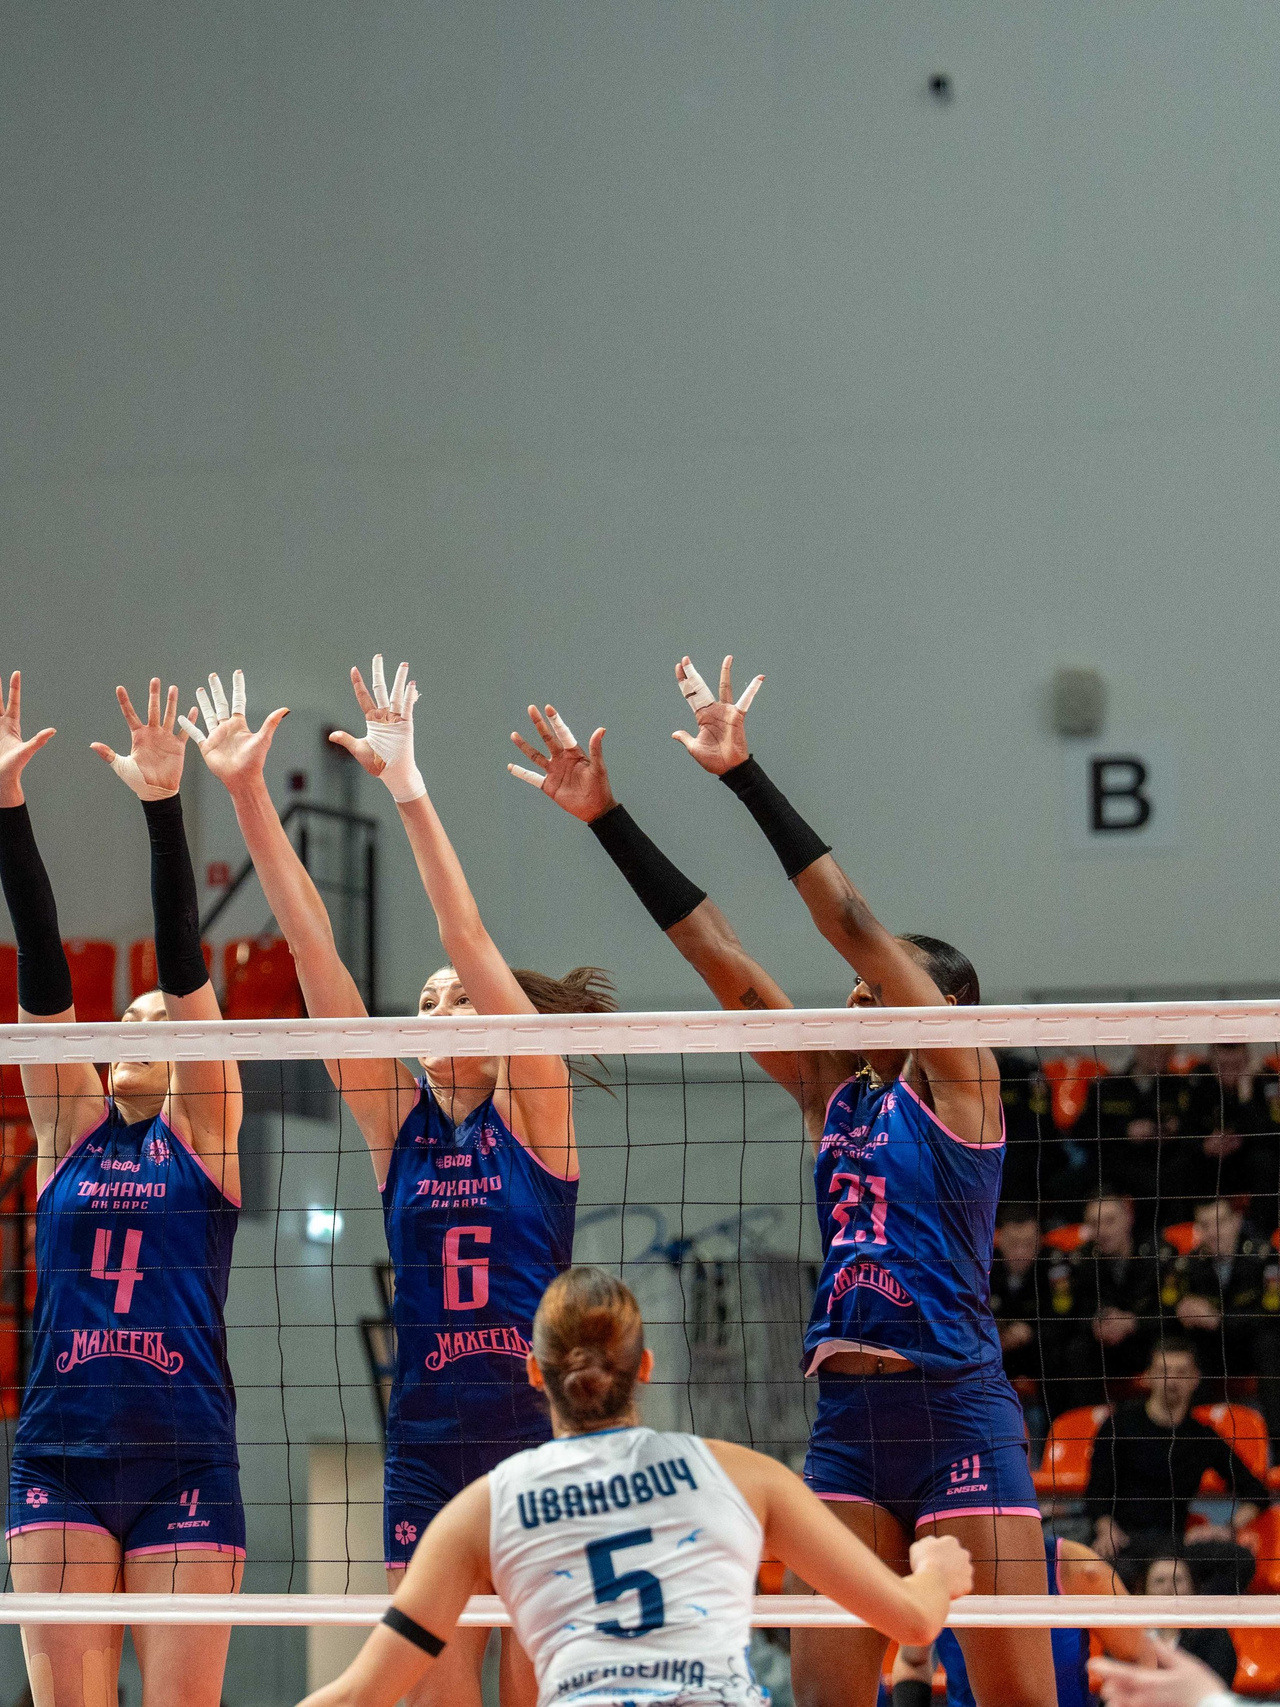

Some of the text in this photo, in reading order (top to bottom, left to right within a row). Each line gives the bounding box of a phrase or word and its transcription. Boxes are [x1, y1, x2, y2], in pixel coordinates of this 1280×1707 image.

[77, 1181, 166, 1198] ДИНАМО
[416, 1175, 502, 1197] ДИНАМО
[113, 1200, 149, 1210] БАРС
[829, 1172, 888, 1247] 21
[90, 1228, 144, 1314] 4
[442, 1225, 492, 1311] 6
[179, 1488, 200, 1517] 4
[946, 1484, 988, 1496] ENSEN
[166, 1519, 211, 1530] ENSEN
[585, 1527, 664, 1639] 5
